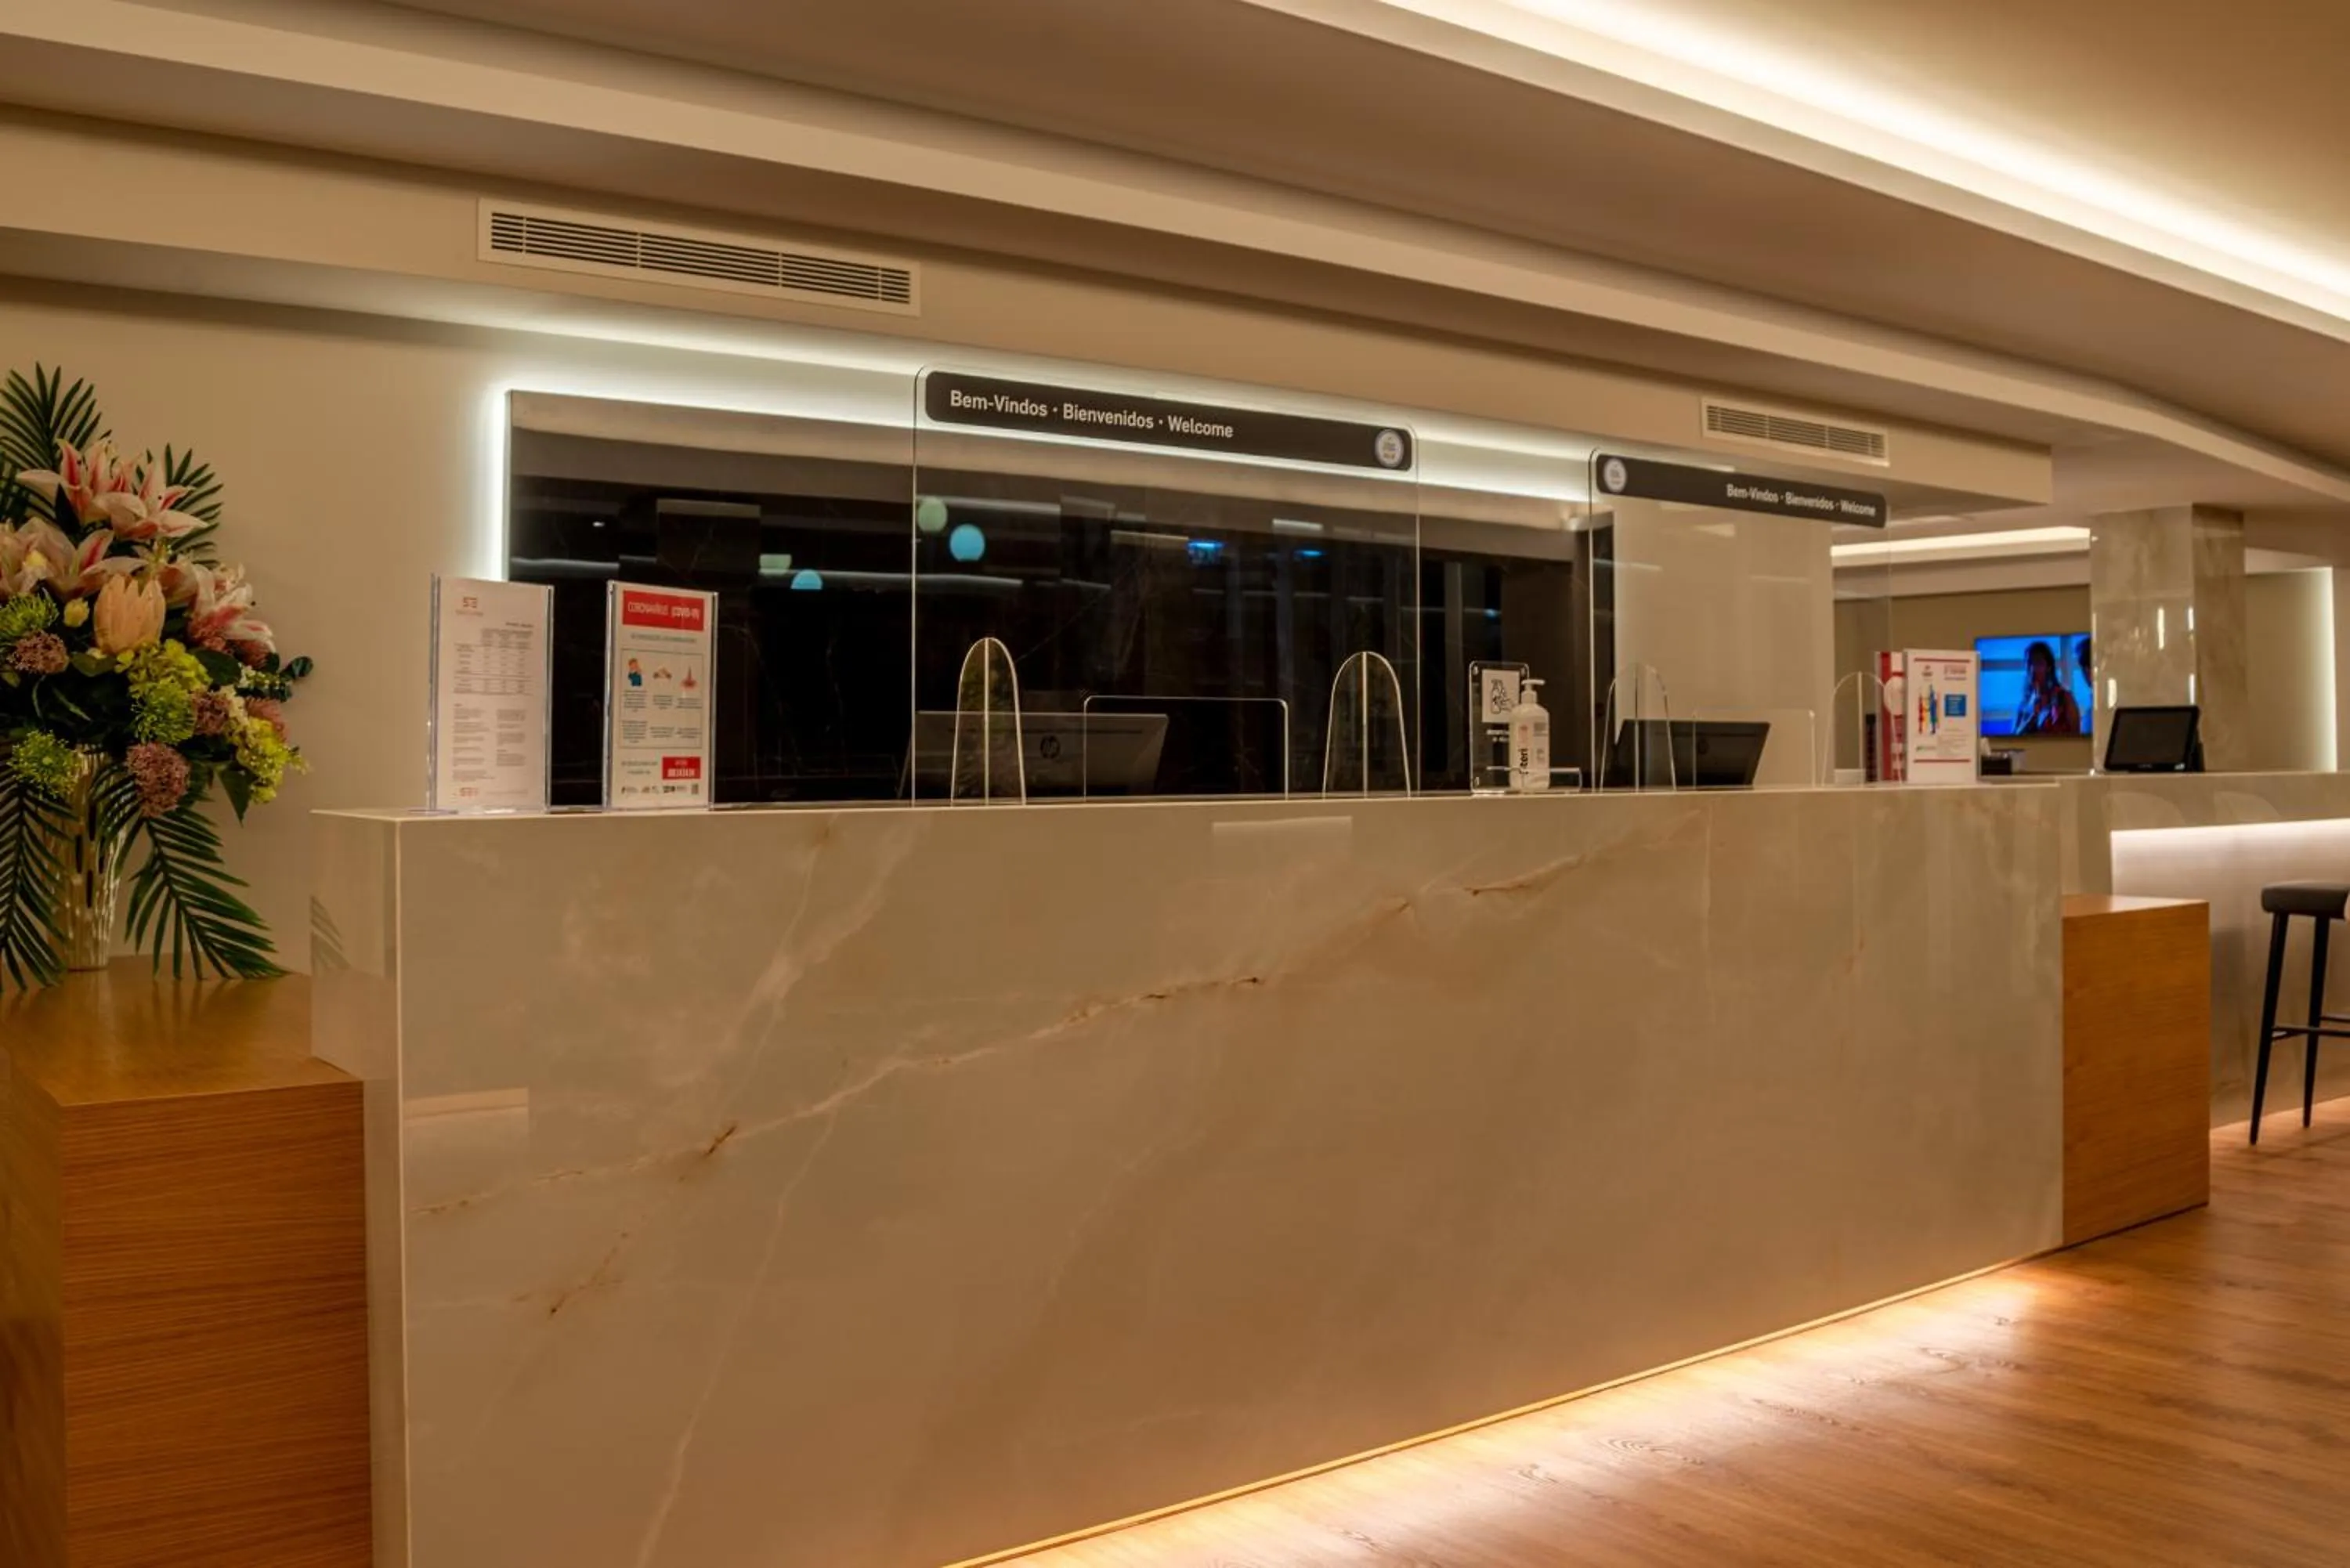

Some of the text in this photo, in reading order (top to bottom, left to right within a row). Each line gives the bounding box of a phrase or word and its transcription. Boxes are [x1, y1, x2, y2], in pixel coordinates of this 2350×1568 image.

[950, 389, 1235, 439] Bem-Vindos Bienvenidos Welcome
[1726, 482, 1877, 517] Bem-Vindos Bienvenidos Welcome
